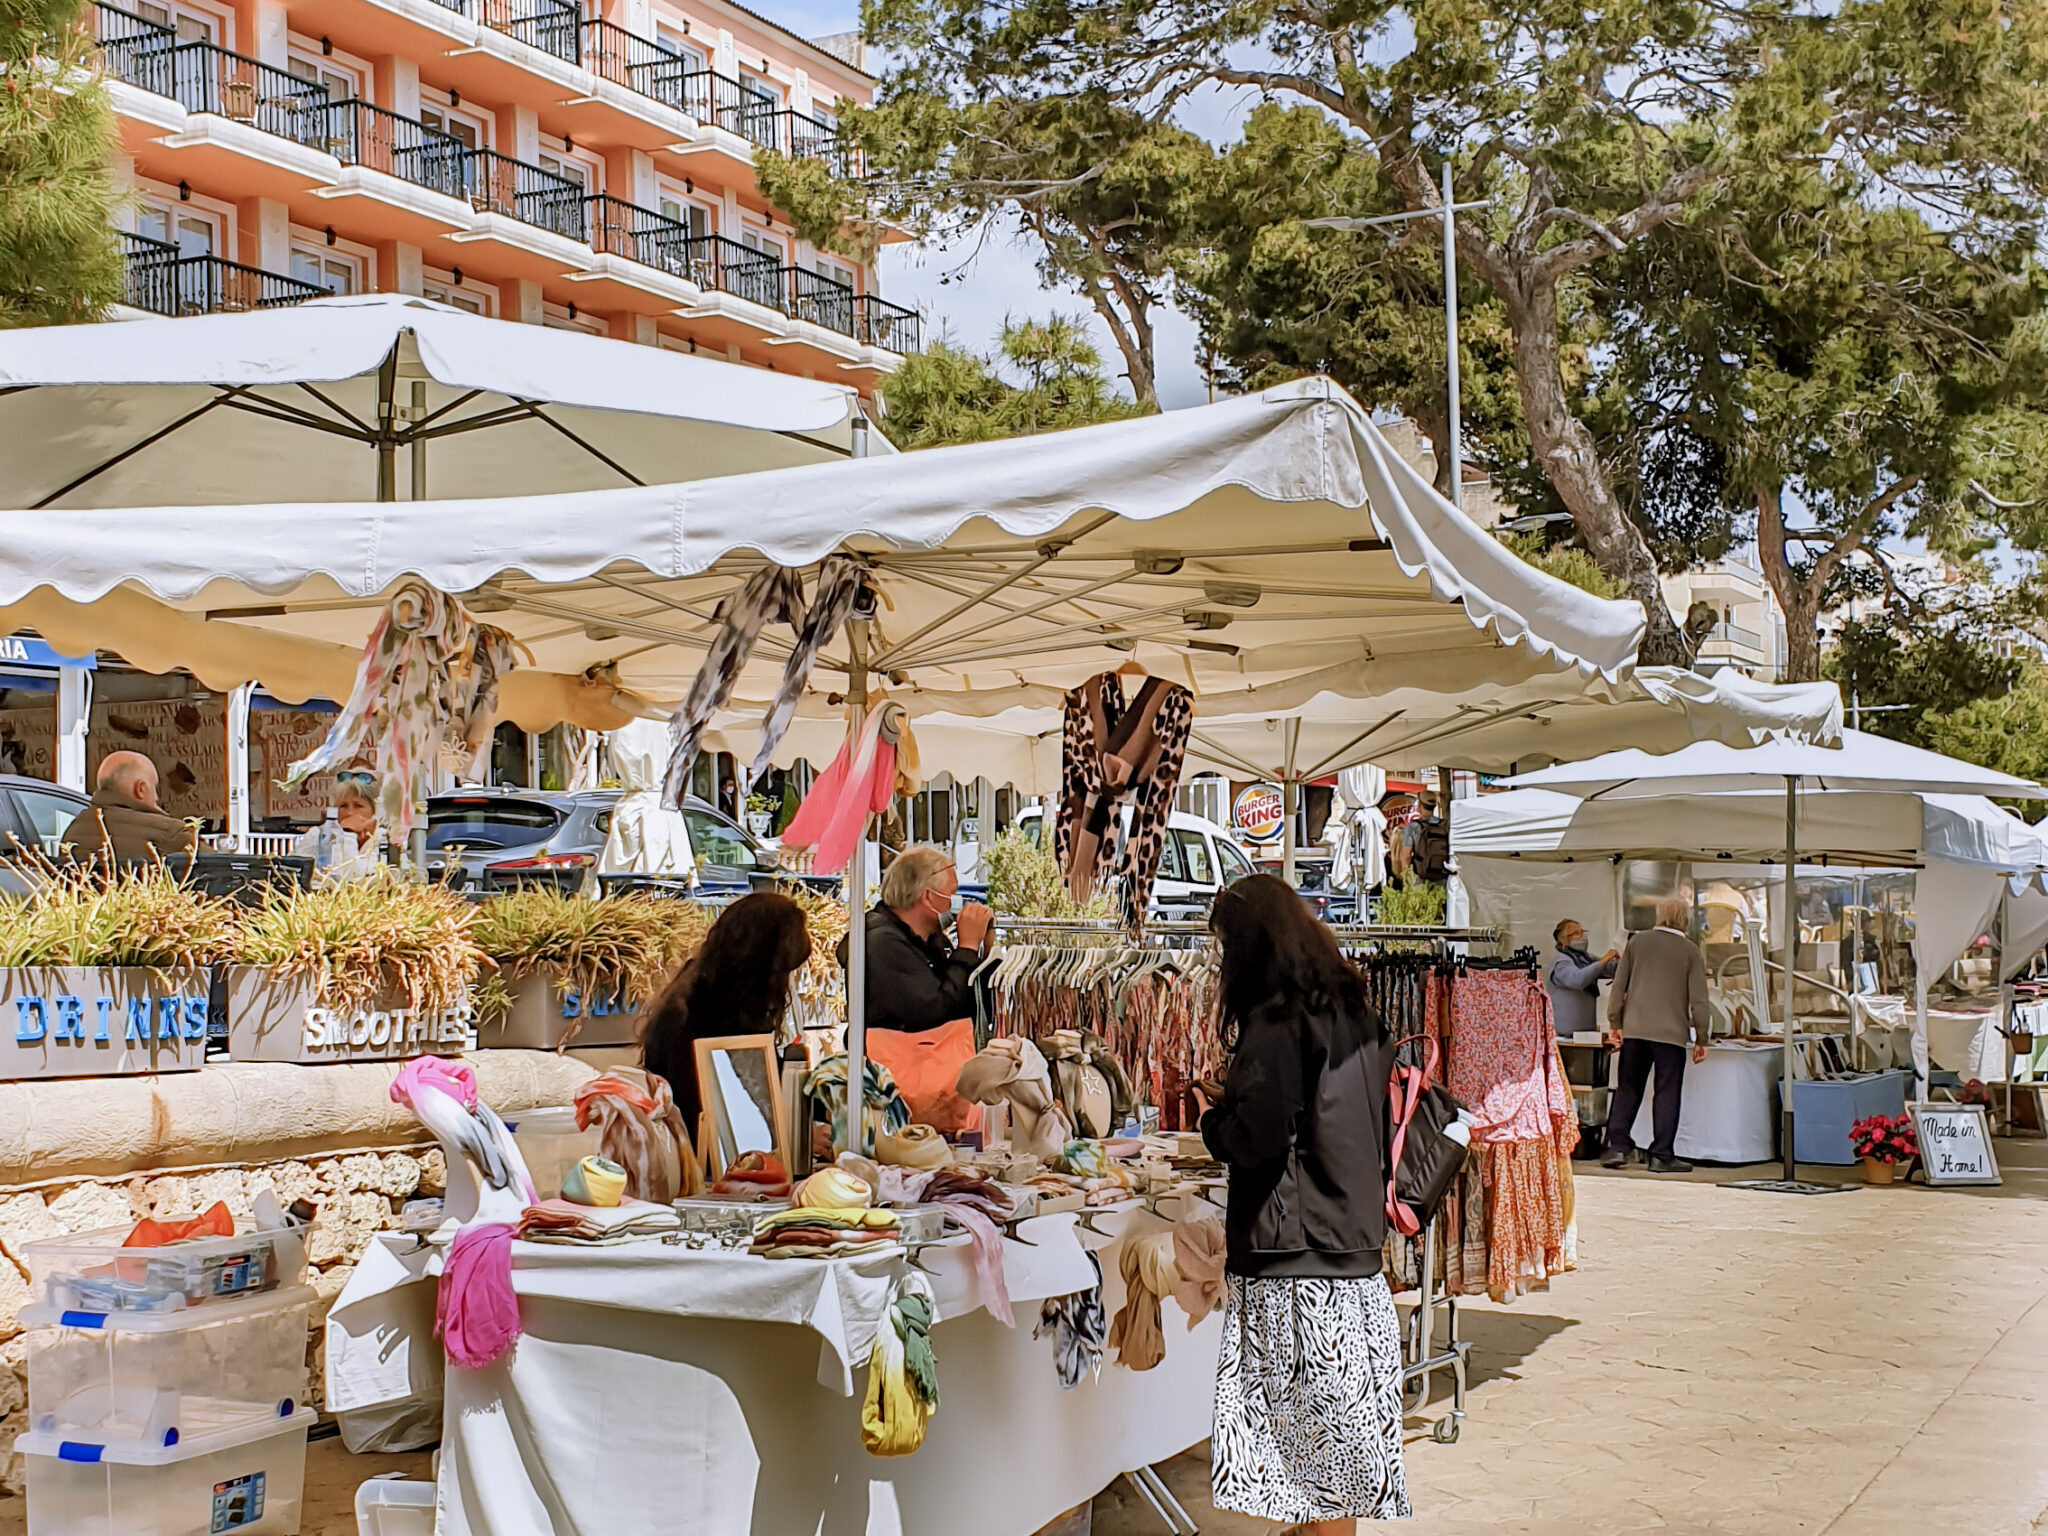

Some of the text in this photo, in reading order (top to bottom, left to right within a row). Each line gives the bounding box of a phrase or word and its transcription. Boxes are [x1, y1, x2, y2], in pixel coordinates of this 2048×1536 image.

[1238, 794, 1280, 816] BURGER
[1240, 804, 1283, 828] KING
[16, 995, 207, 1042] DRINKS
[1923, 1116, 1977, 1144] Made in
[1939, 1153, 1984, 1173] Home!
